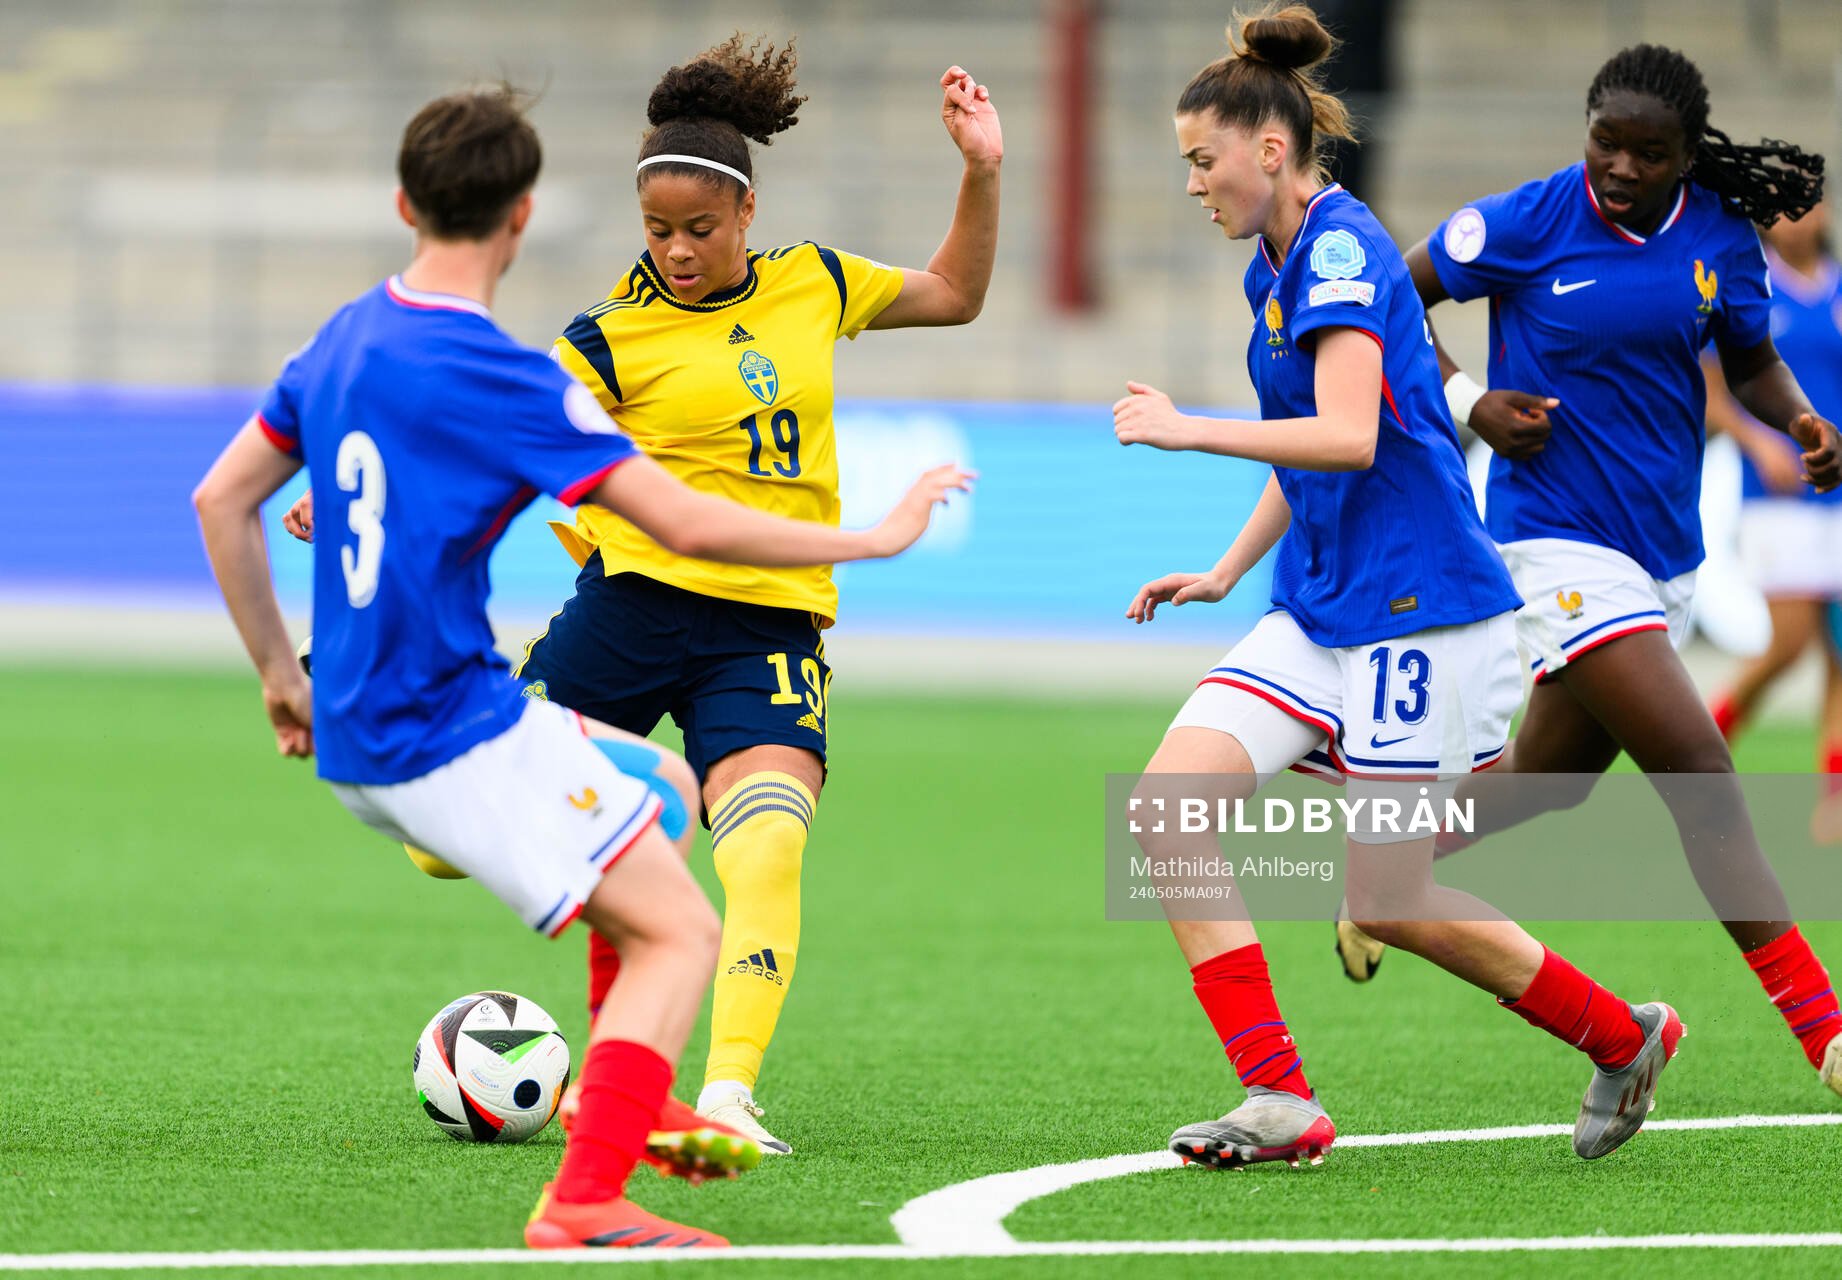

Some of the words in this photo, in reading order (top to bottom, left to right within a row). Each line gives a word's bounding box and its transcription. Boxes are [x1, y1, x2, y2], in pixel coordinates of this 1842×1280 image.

[728, 334, 755, 345] adidas
[739, 409, 801, 478] 19
[336, 430, 387, 609] 3
[767, 652, 823, 718] 19
[1369, 646, 1432, 726] 13
[728, 963, 784, 986] adidas
